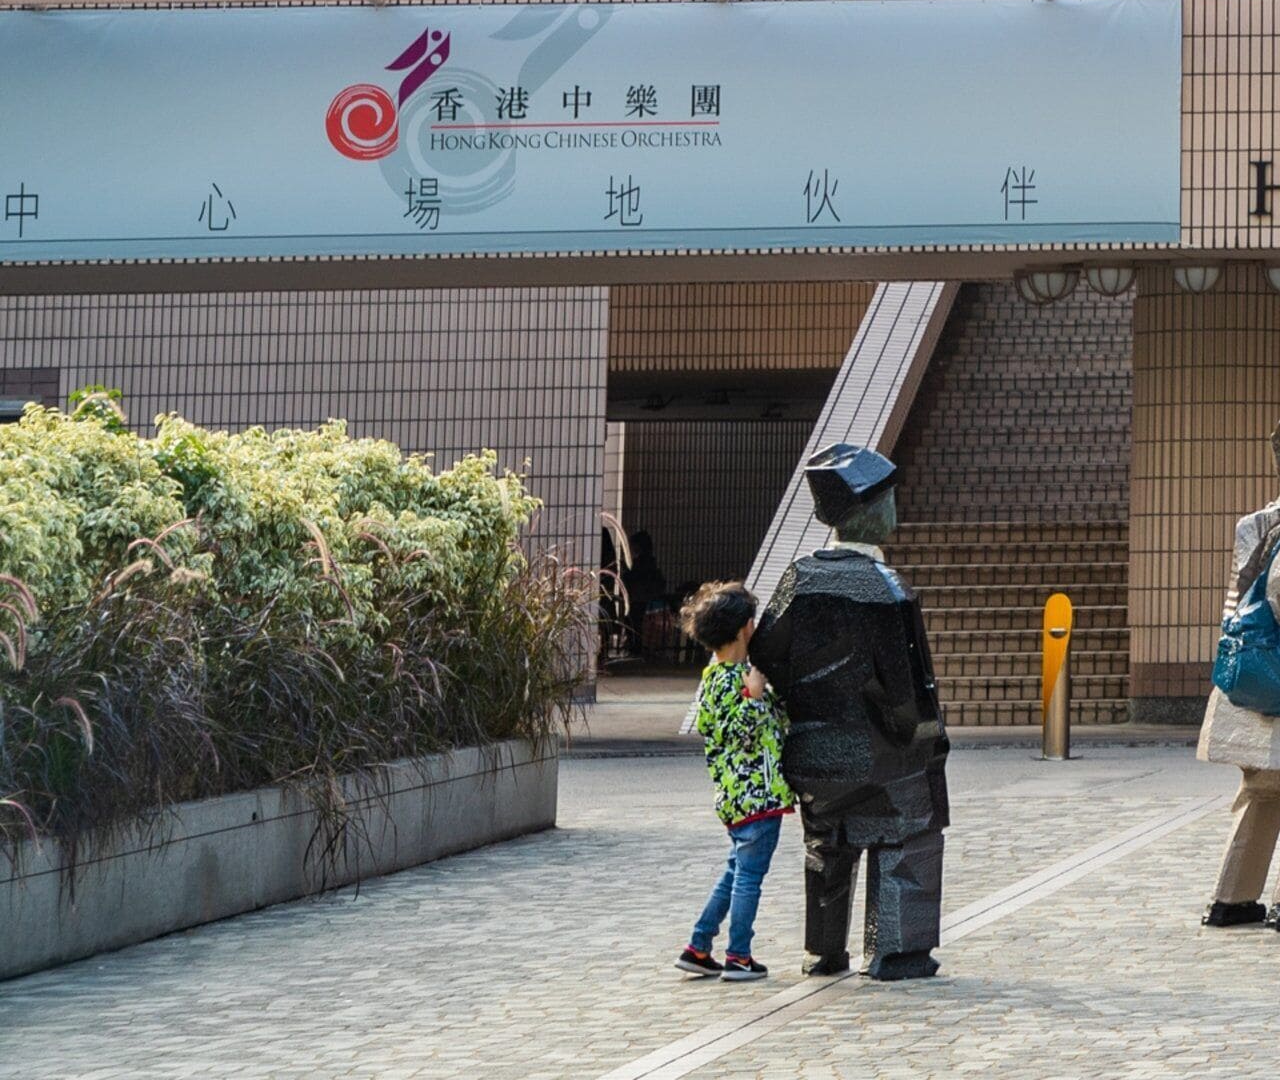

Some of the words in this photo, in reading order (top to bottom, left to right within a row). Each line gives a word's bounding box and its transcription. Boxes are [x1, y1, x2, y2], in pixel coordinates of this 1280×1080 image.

[429, 84, 721, 121] 香港中樂團
[430, 131, 486, 151] HONG
[488, 131, 541, 150] KONG
[543, 130, 619, 149] CHINESE
[620, 129, 722, 148] ORCHESTRA
